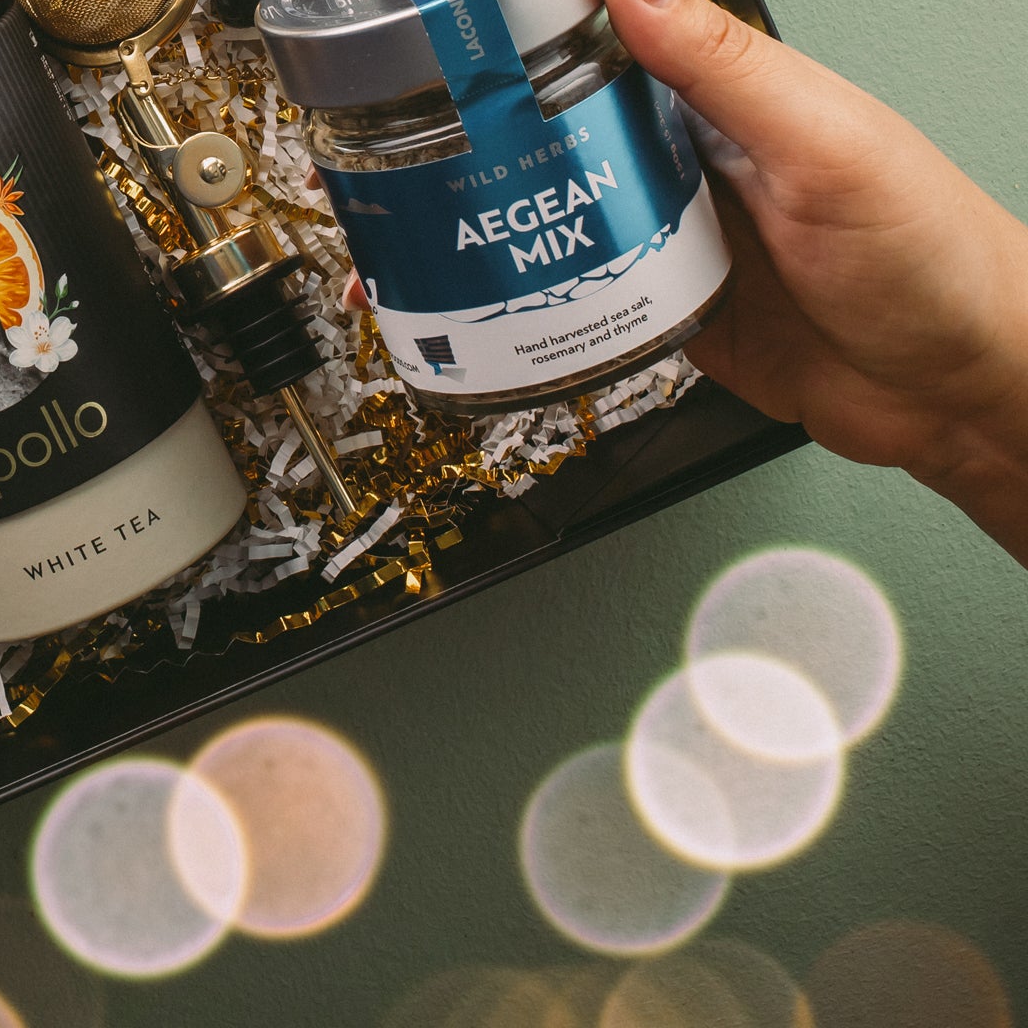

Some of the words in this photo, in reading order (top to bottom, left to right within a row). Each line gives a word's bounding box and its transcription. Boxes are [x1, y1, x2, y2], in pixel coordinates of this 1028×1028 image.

[446, 165, 508, 193] WILD
[517, 126, 590, 170] HERBS
[457, 159, 618, 251] AEGEAN
[508, 215, 595, 273] MIX
[514, 337, 548, 355] Hand
[549, 315, 609, 346] harvested
[610, 308, 630, 322] sea
[631, 296, 653, 313] salt,
[531, 342, 586, 365] rosemary
[589, 329, 612, 347] and
[613, 313, 649, 335] thyme
[23, 536, 107, 581] WHITE
[113, 508, 161, 541] TEA
